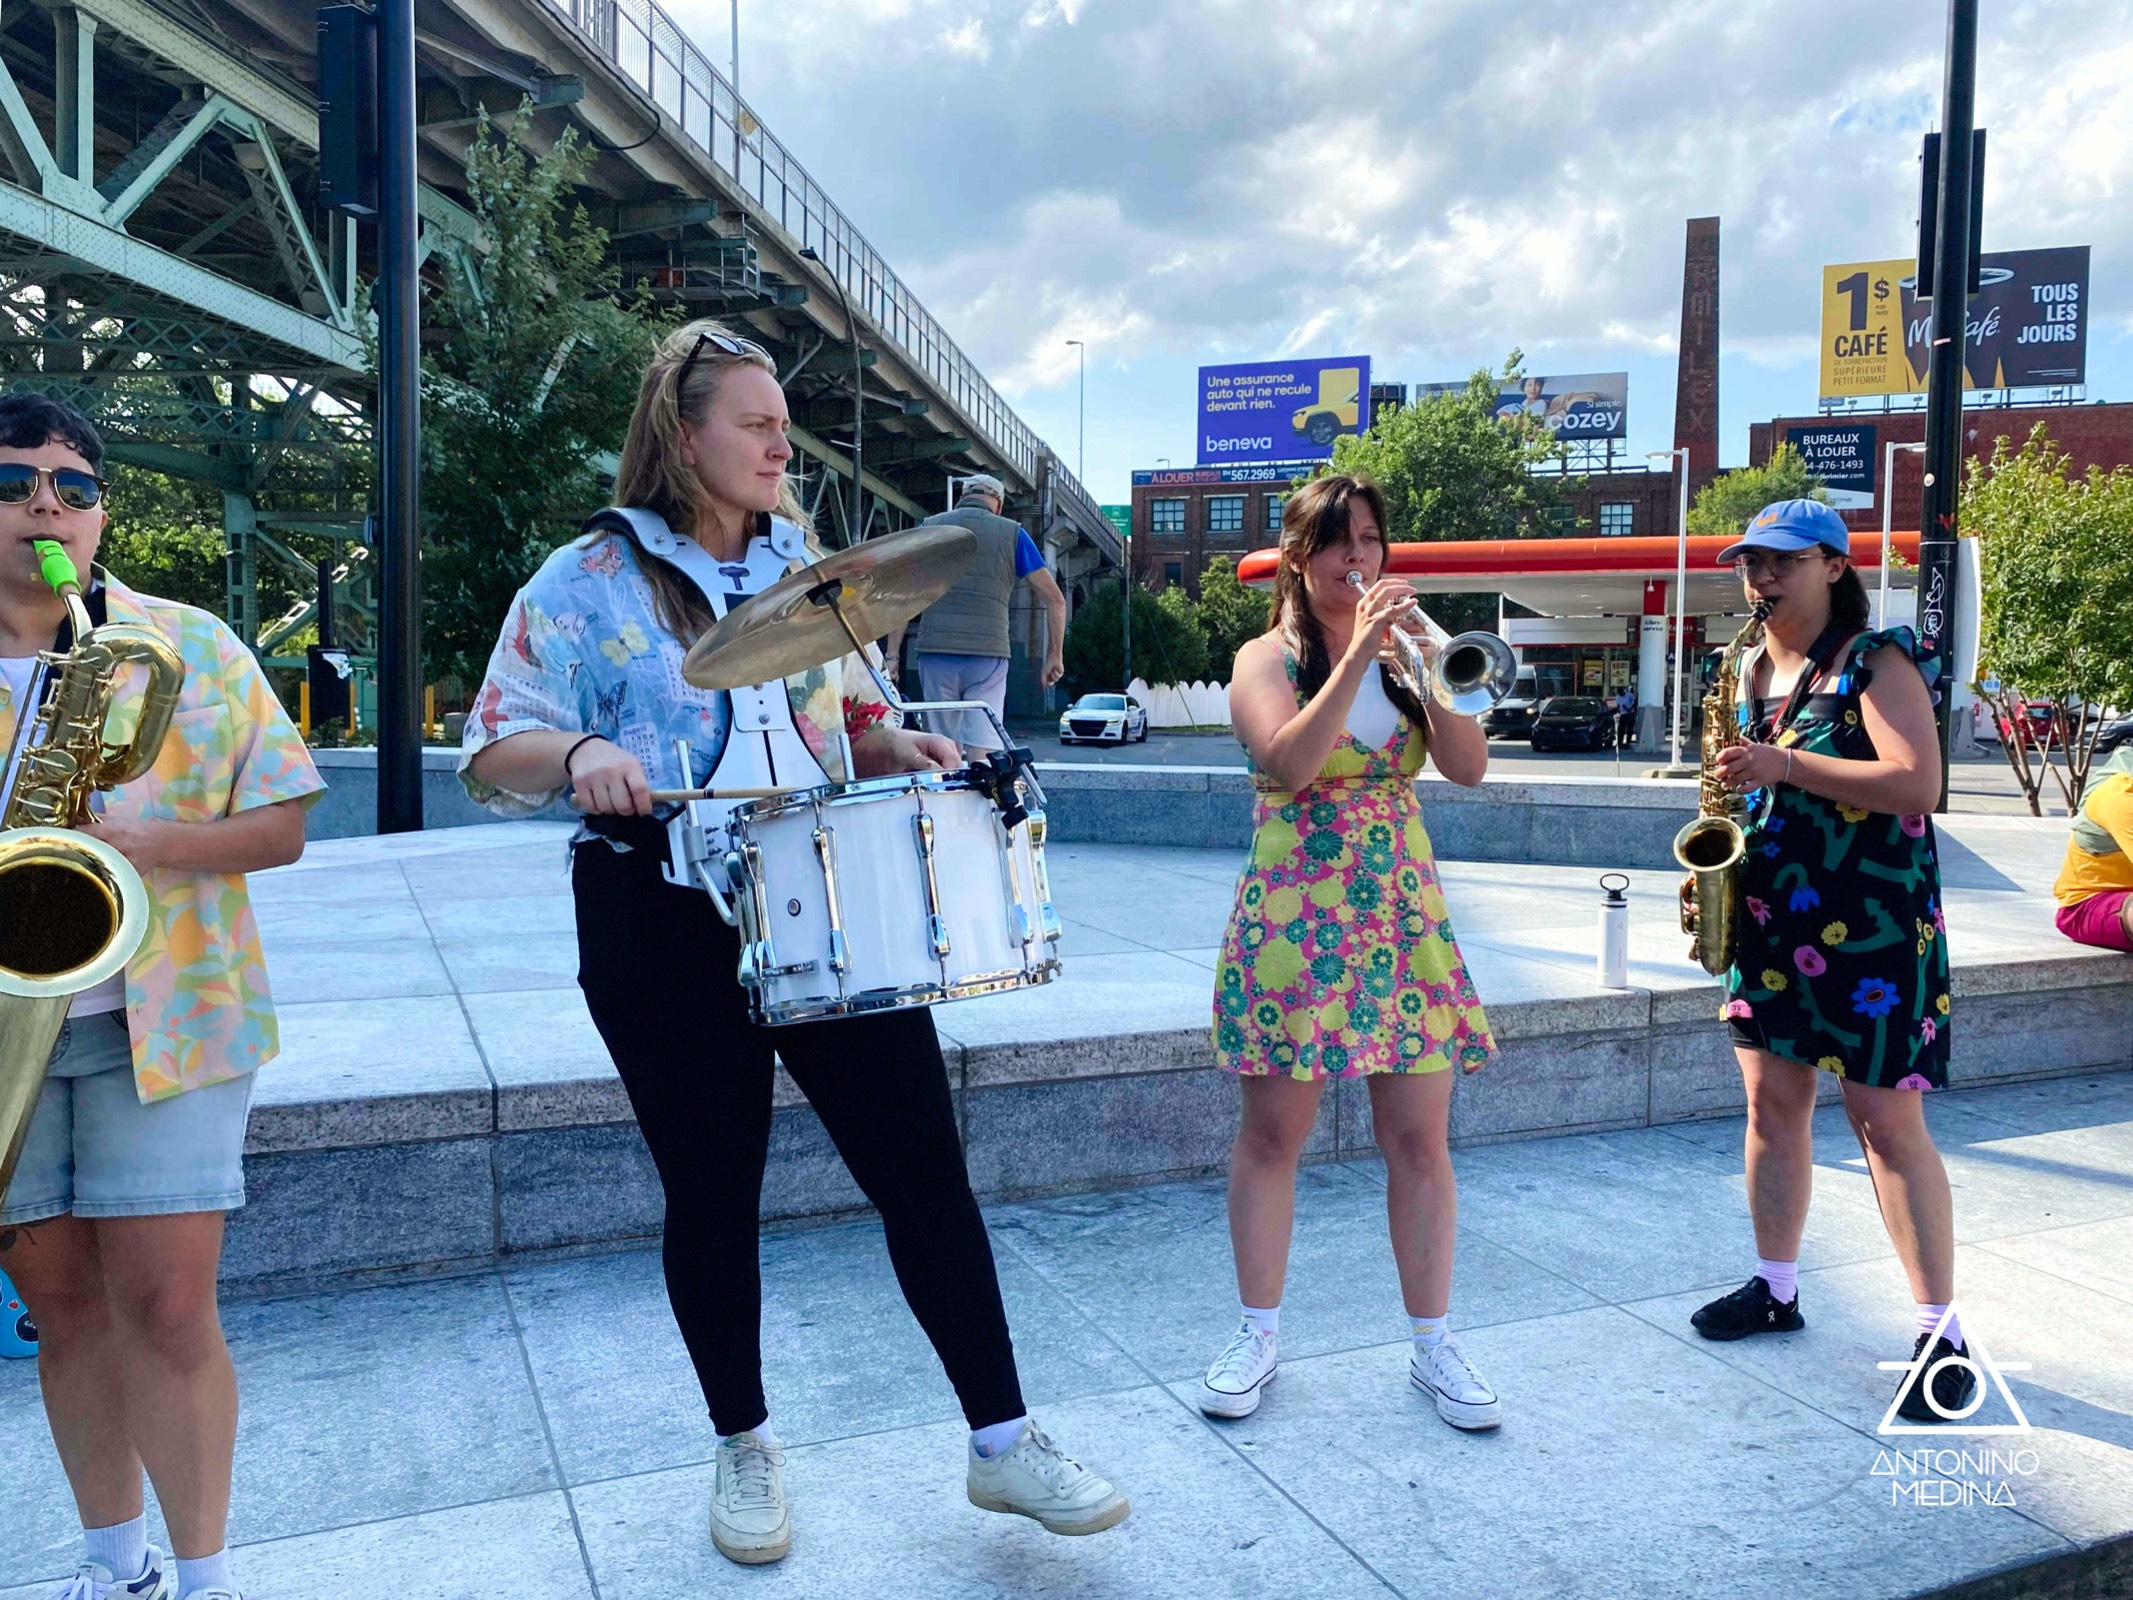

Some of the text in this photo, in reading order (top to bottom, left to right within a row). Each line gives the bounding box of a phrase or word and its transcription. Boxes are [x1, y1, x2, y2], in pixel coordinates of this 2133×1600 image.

[2031, 283, 2078, 303] TOUS
[1837, 272, 1890, 331] 1 $
[2046, 303, 2078, 322] LES
[2017, 323, 2077, 344] JOURS
[1834, 326, 1888, 358] CAFÉ
[1207, 373, 1294, 387] Une assurance
[1833, 375, 1887, 386] PETIT FORMAT
[1206, 383, 1312, 402] auto qui ne recule
[1206, 398, 1275, 412] devant rien.
[1547, 411, 1622, 431] cozey
[1206, 435, 1272, 452] beneva
[1803, 433, 1860, 445] BUREAUX
[1805, 445, 1857, 457] À LOUER
[1804, 460, 1864, 470] 14-476-1493
[1159, 472, 1194, 483] LOUER
[1231, 468, 1275, 480] 567.2969
